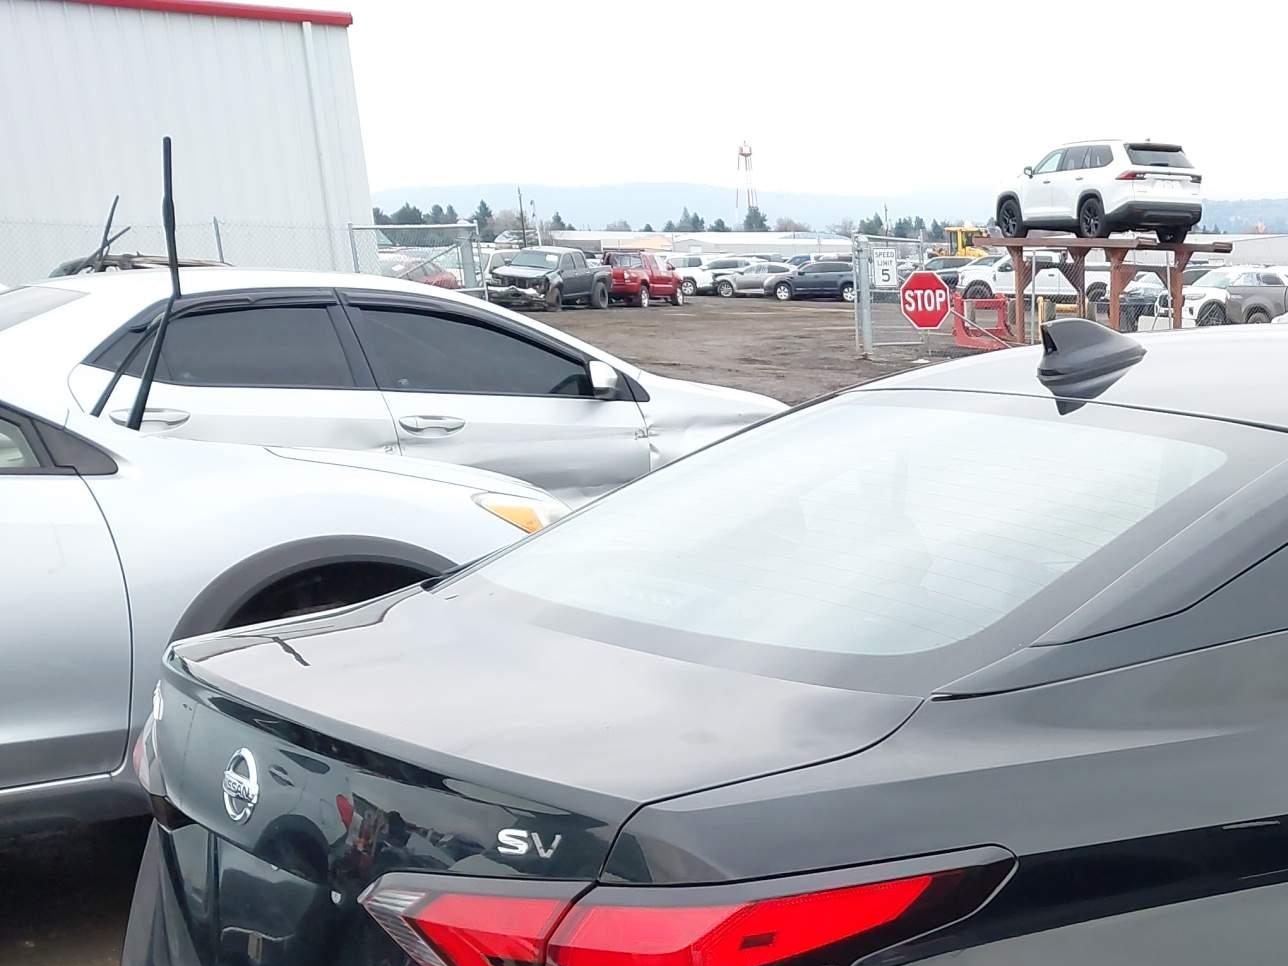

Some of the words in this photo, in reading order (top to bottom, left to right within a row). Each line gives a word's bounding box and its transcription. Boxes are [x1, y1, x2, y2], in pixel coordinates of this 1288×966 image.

[881, 268, 891, 282] 5
[904, 289, 946, 312] STOP
[497, 828, 562, 858] SV
